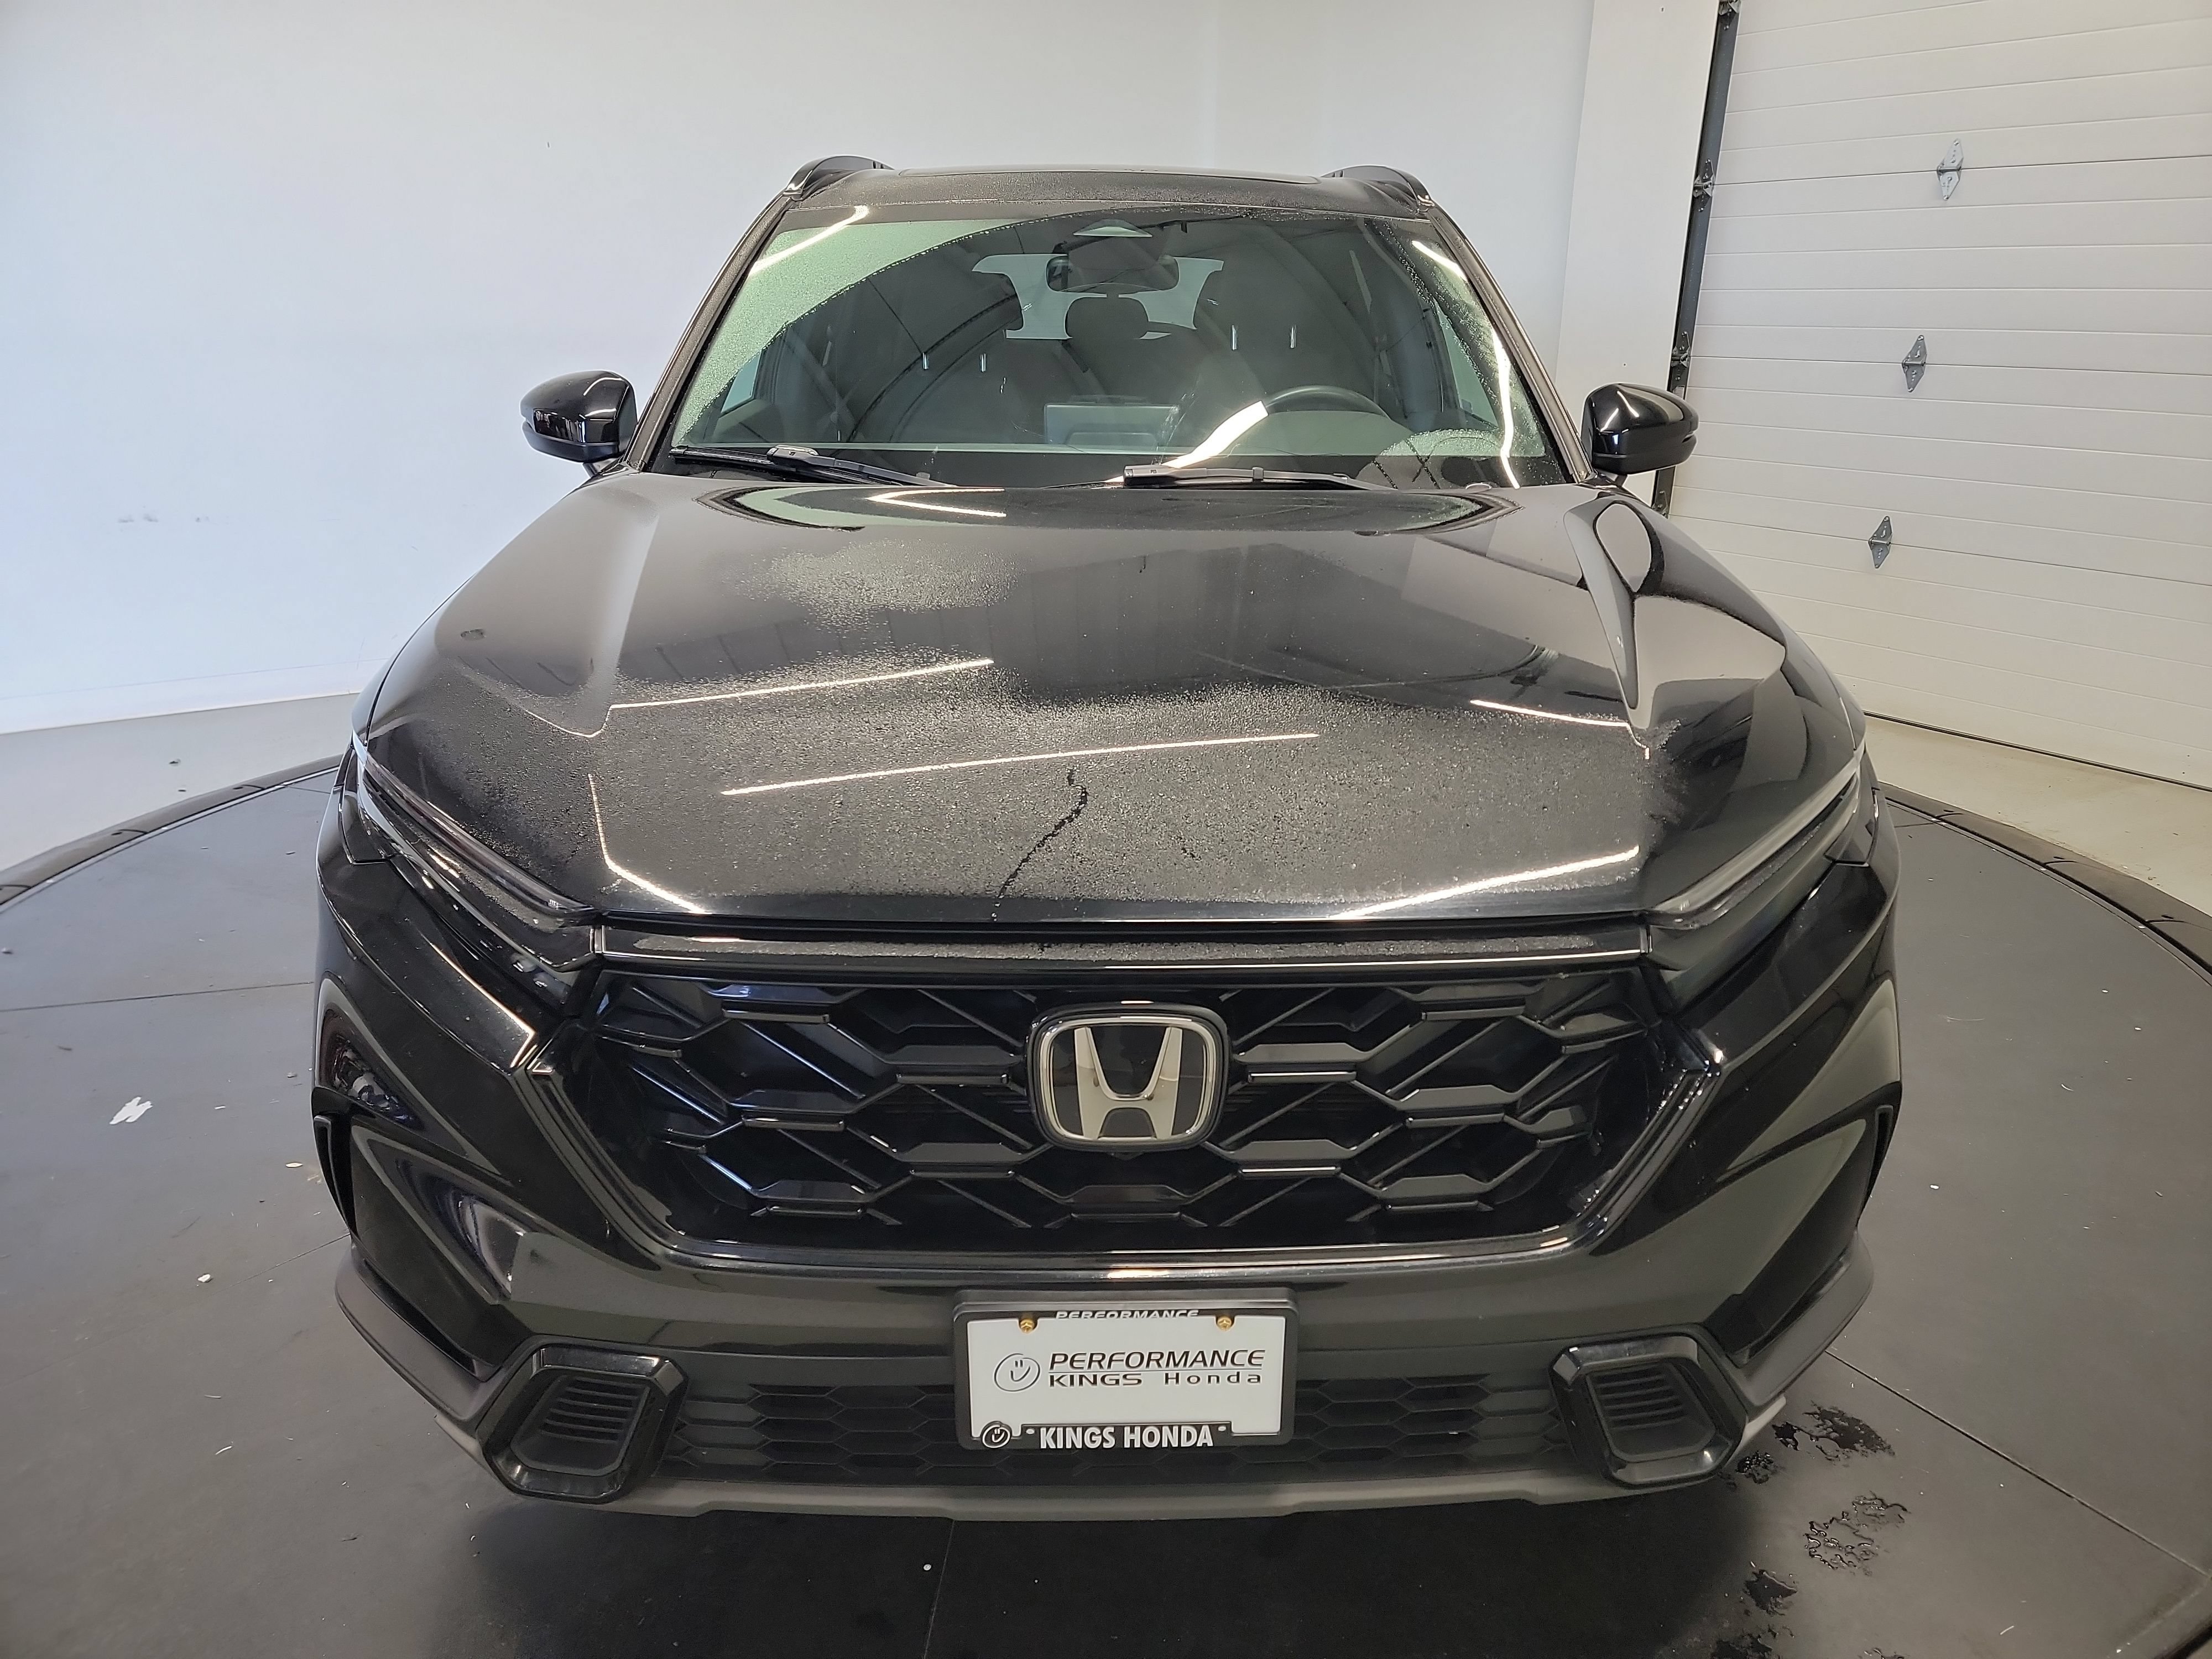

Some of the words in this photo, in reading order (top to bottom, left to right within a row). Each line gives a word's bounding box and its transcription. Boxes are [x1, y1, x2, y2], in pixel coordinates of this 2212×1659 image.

[1055, 1308, 1199, 1320] PERFORMANCE
[1048, 1349, 1266, 1371] PERFORMANCE
[1049, 1373, 1143, 1387] KINGS
[1164, 1371, 1262, 1385] Honda
[1040, 1426, 1115, 1449] KINGS
[1124, 1424, 1214, 1448] HONDA
